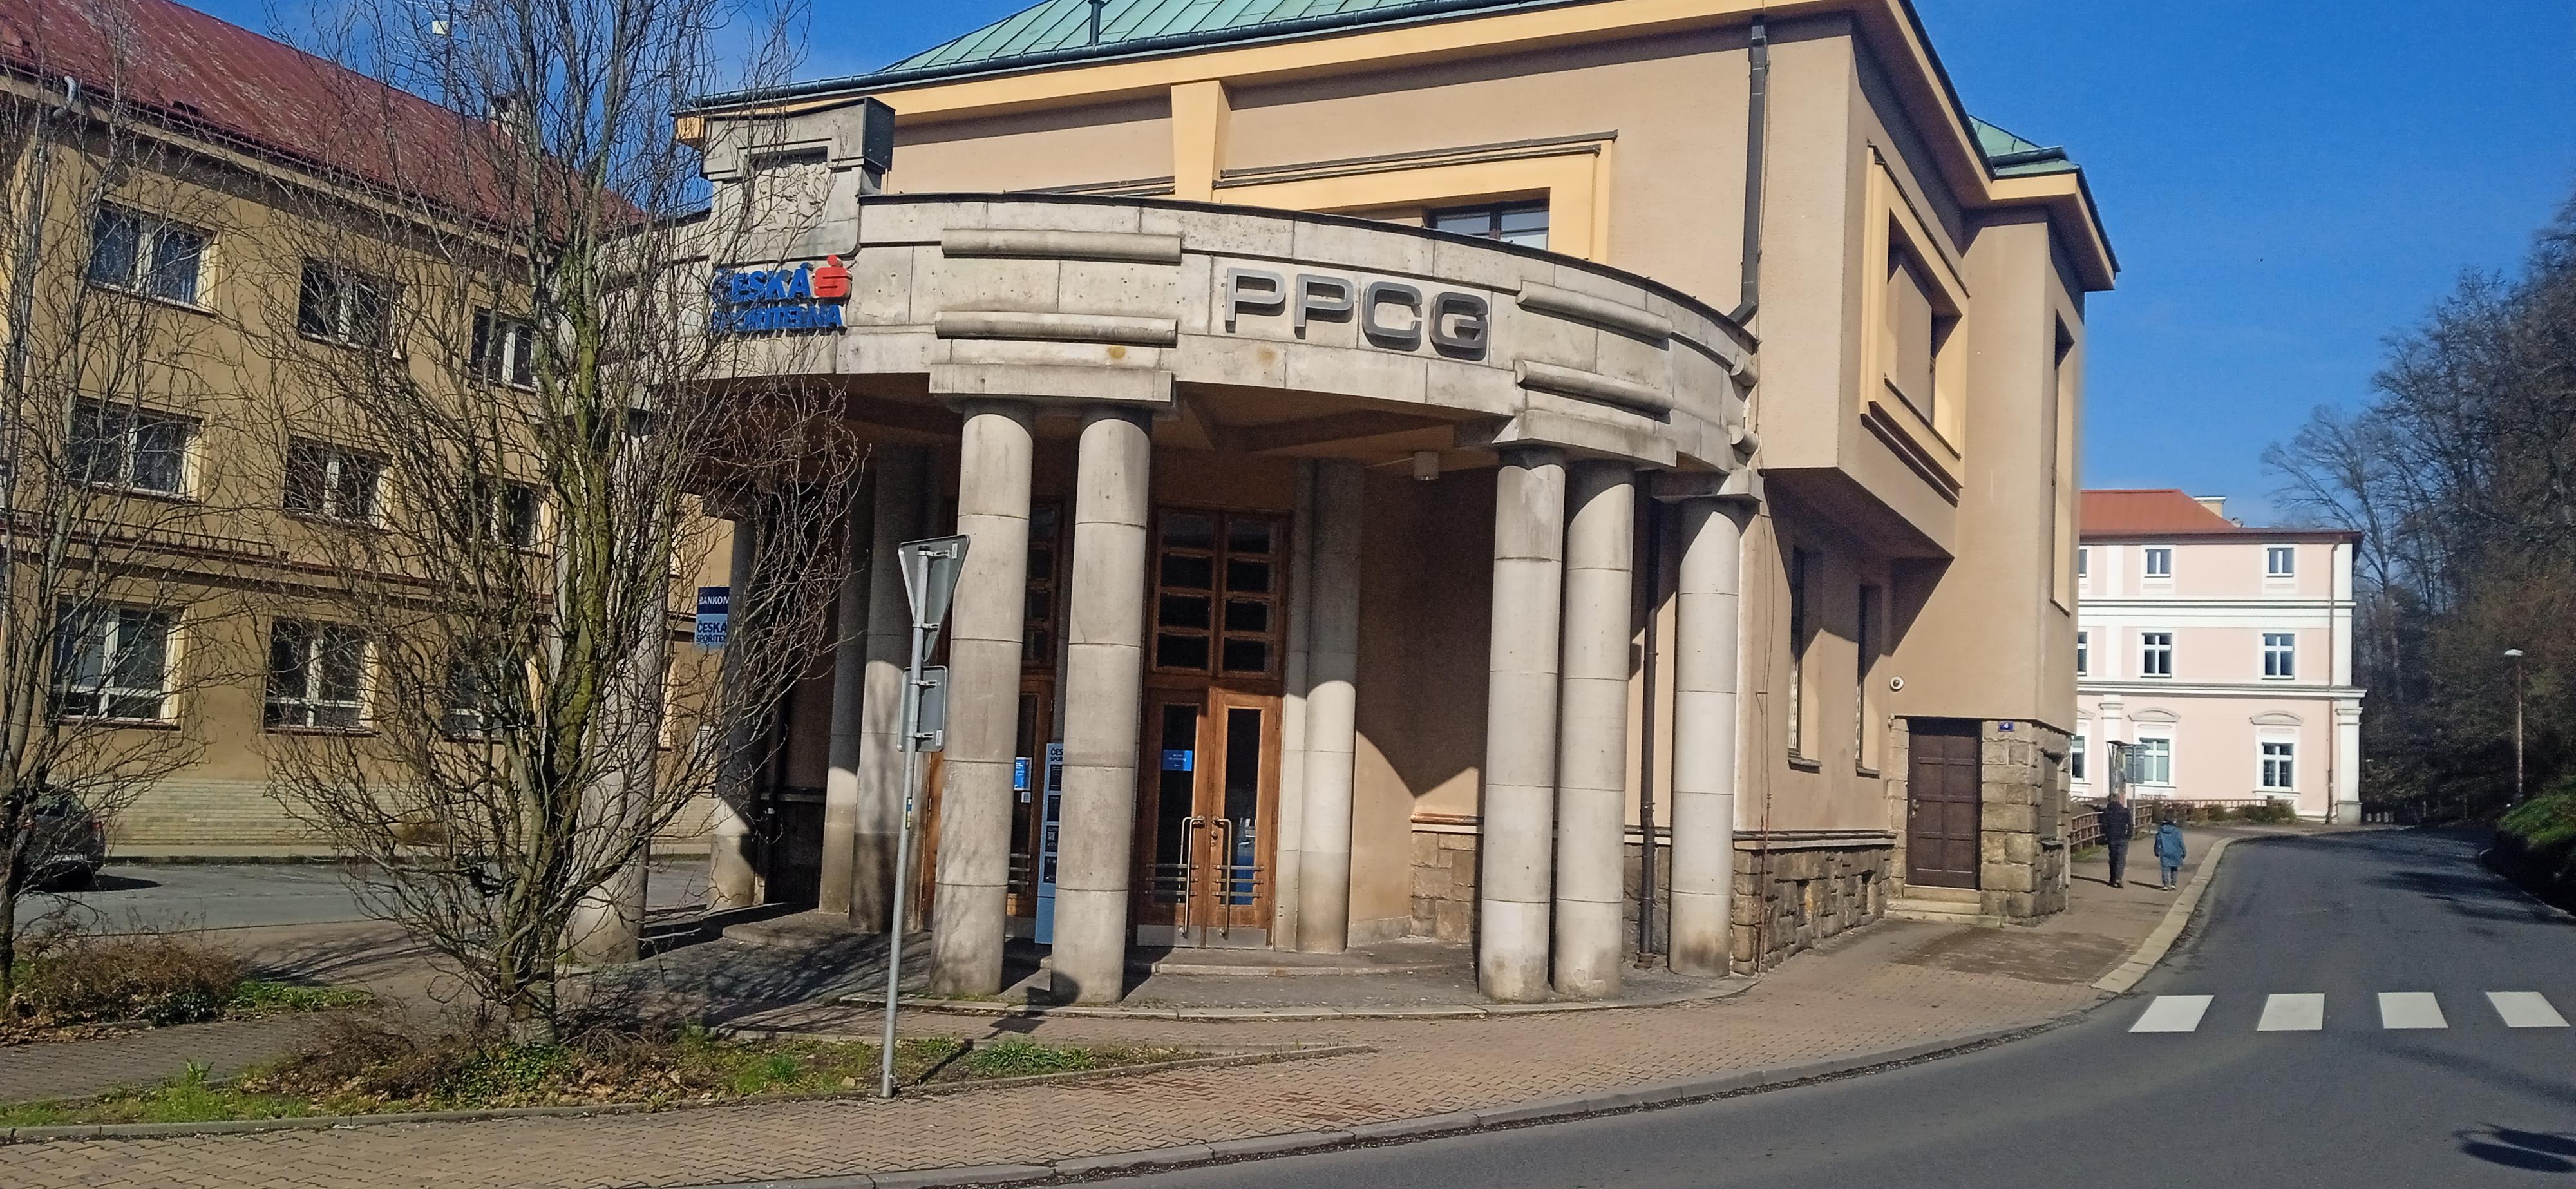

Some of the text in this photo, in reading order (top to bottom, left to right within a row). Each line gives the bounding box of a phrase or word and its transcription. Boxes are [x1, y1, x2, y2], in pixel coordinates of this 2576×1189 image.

[712, 304, 845, 334] OITELNA
[1225, 267, 1489, 361] PPCG
[697, 620, 727, 633] ČESKÁ
